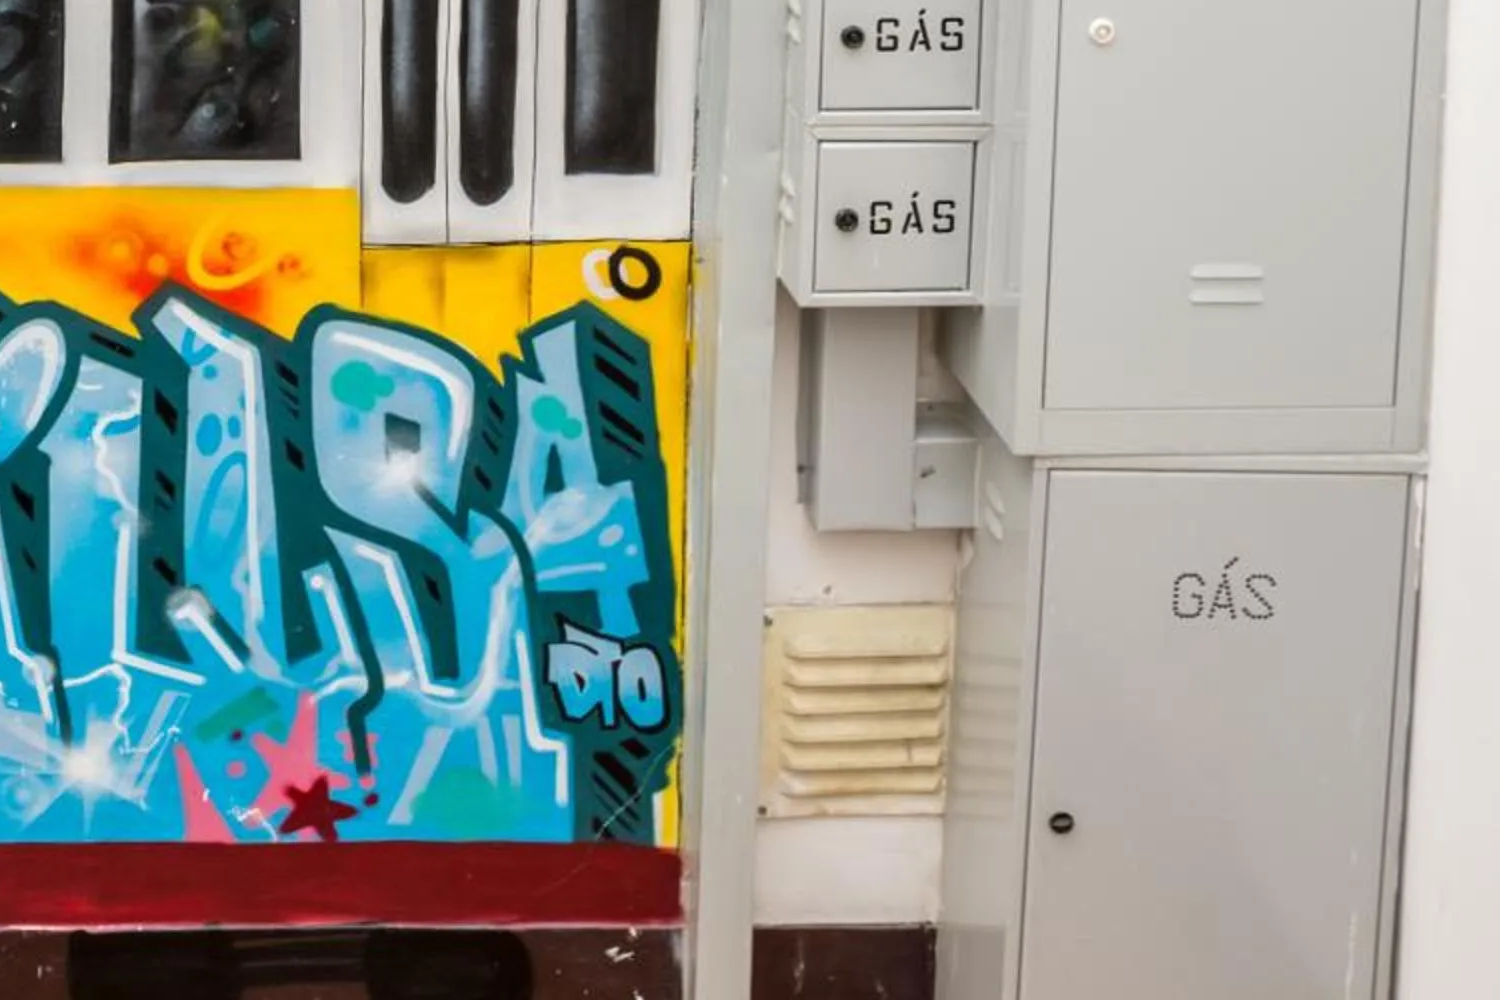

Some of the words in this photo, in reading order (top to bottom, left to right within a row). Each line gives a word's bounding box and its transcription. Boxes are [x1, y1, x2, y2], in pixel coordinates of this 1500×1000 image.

[875, 8, 965, 52] GÁS
[868, 191, 956, 235] GÁS
[1173, 557, 1277, 619] GÁS
